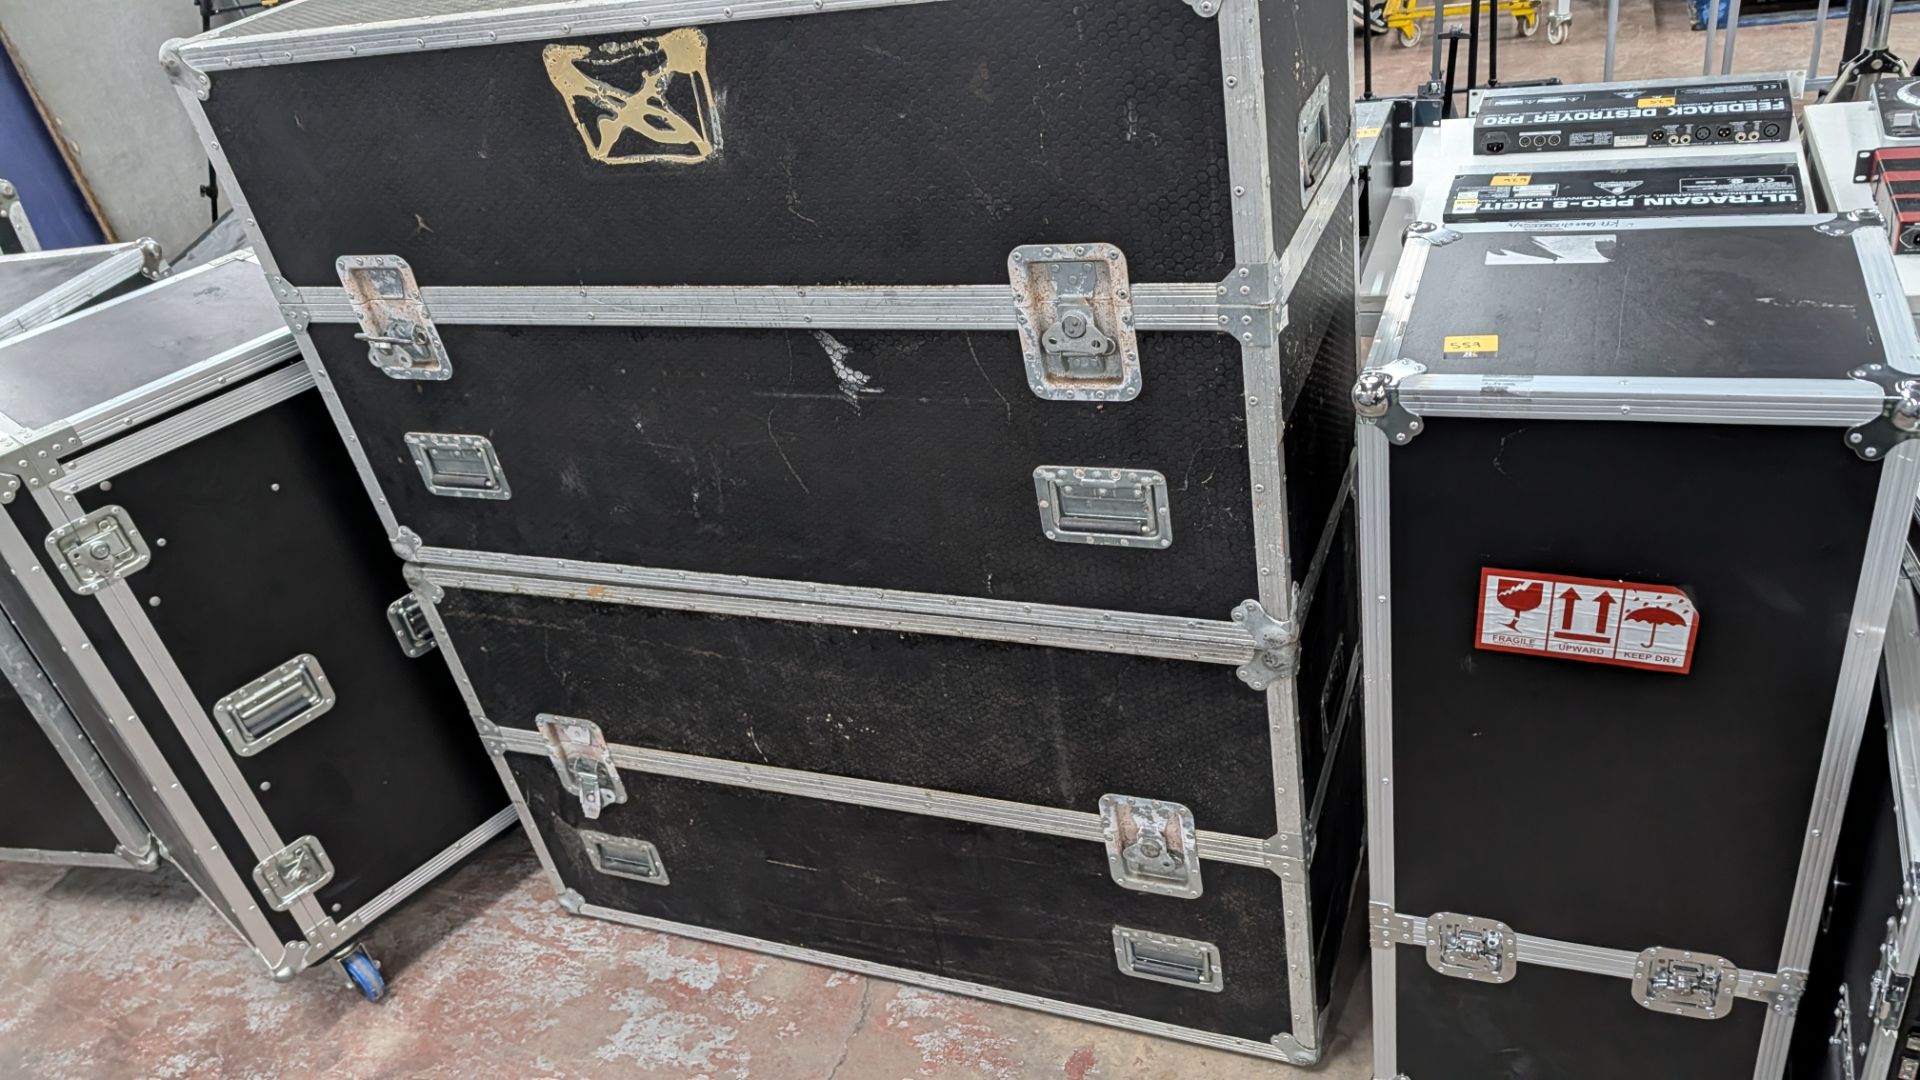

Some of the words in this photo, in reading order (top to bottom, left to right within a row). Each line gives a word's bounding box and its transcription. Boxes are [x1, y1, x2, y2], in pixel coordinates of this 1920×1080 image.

[1667, 101, 1785, 116] FEEDBACK
[1482, 115, 1524, 126] PRO
[1533, 108, 1657, 123] DESTROYER
[1476, 201, 1544, 211] DIGIT
[1551, 199, 1634, 209] PRO-8
[1644, 194, 1798, 206] ULTRAGAIN
[1492, 633, 1536, 645] FRAGILE
[1558, 643, 1605, 655] UPWARD
[1623, 651, 1652, 661] KEEP
[1655, 653, 1678, 665] DRY
